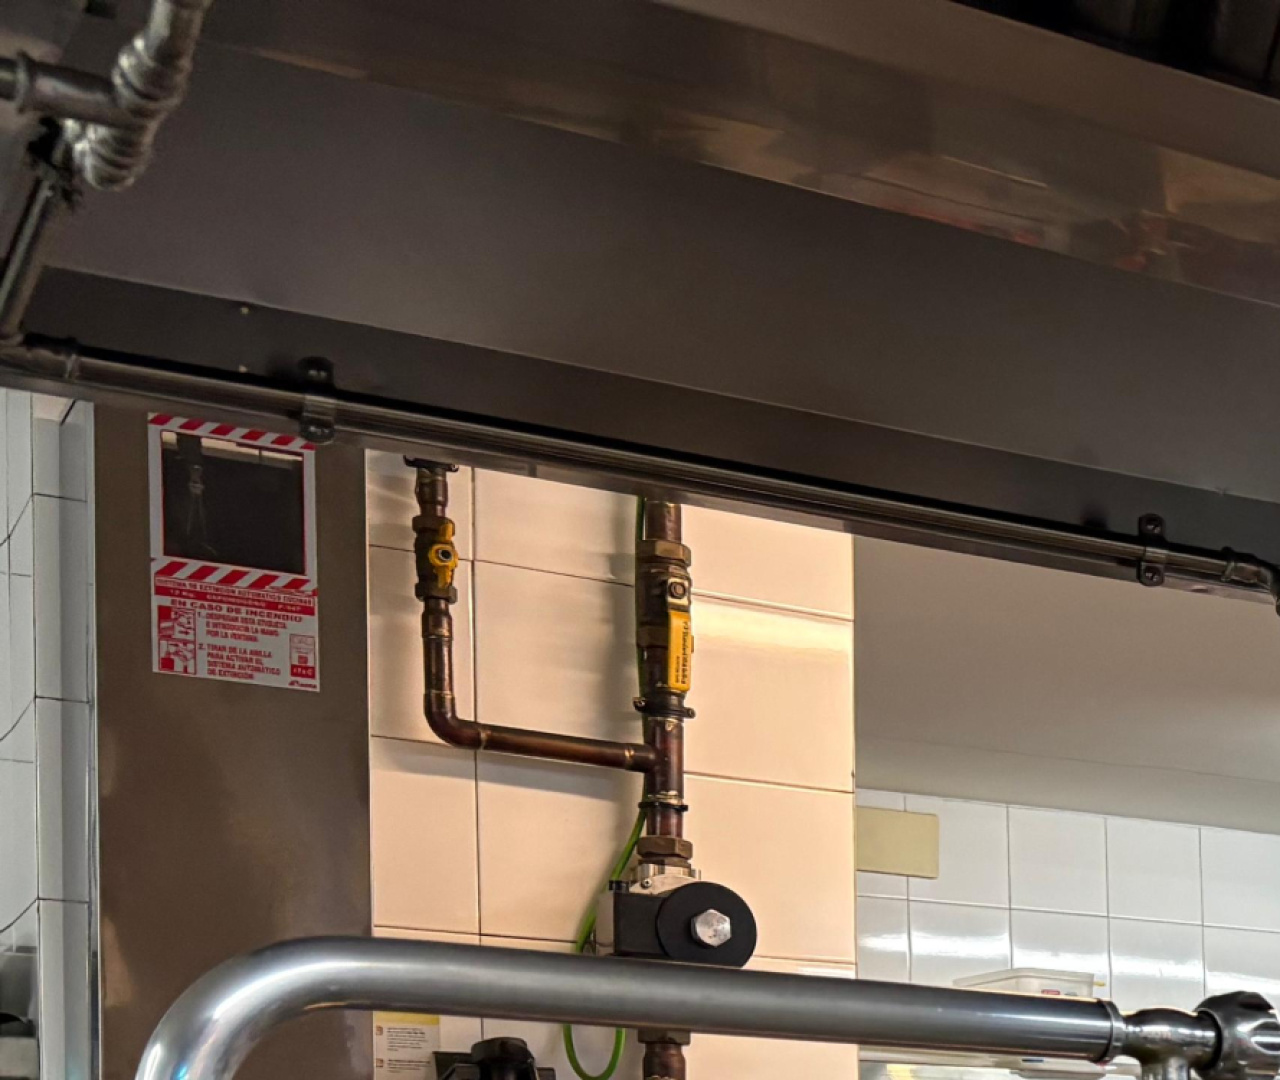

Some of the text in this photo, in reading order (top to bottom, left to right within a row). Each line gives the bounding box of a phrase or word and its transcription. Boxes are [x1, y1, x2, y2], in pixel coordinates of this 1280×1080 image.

[171, 599, 303, 623] EN CASO DE INCENDIO
